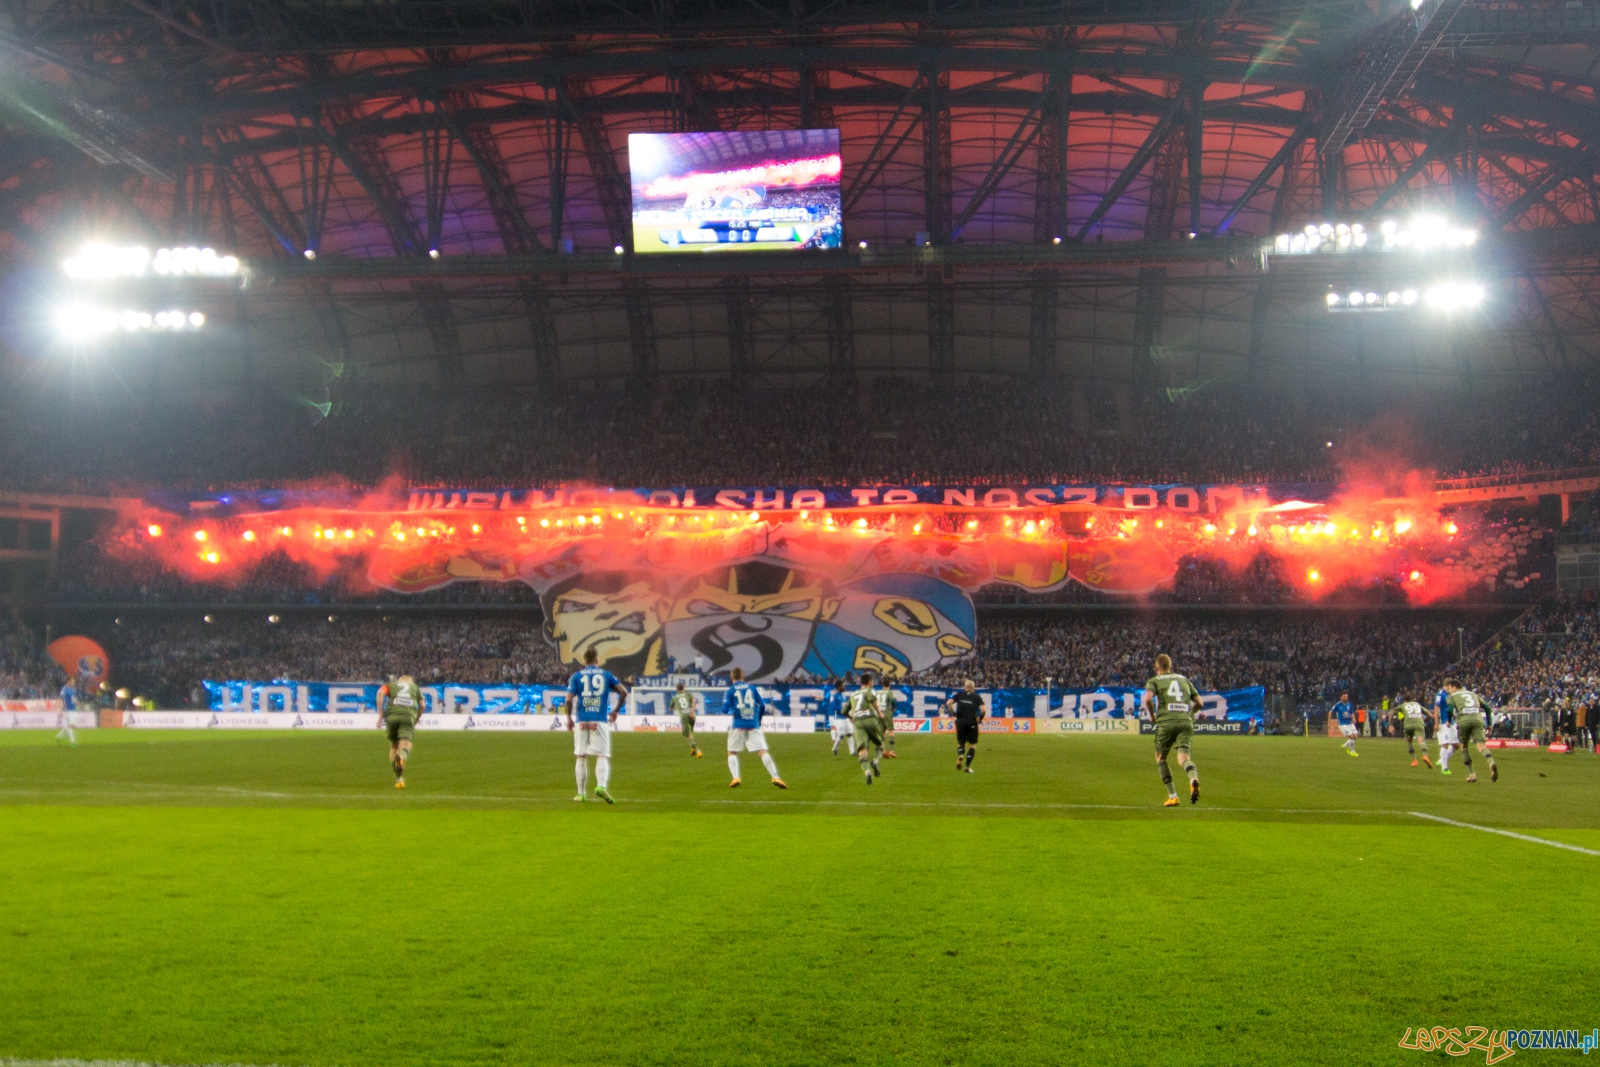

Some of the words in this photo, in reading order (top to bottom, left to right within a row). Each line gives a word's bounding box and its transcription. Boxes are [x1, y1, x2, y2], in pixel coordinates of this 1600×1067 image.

[852, 489, 917, 506] TO
[397, 682, 411, 698] 2
[580, 674, 604, 697] 19
[1167, 680, 1183, 702] 4
[678, 697, 688, 709] 8
[734, 689, 755, 709] 14
[853, 693, 864, 711] 7
[1462, 693, 1475, 708] 3
[1404, 704, 1421, 714] 99
[220, 718, 269, 726] LYONESS
[305, 718, 354, 726] LYONESS
[477, 719, 527, 728] LYONESS
[1061, 722, 1083, 730] LECH
[1091, 719, 1129, 732] PILS
